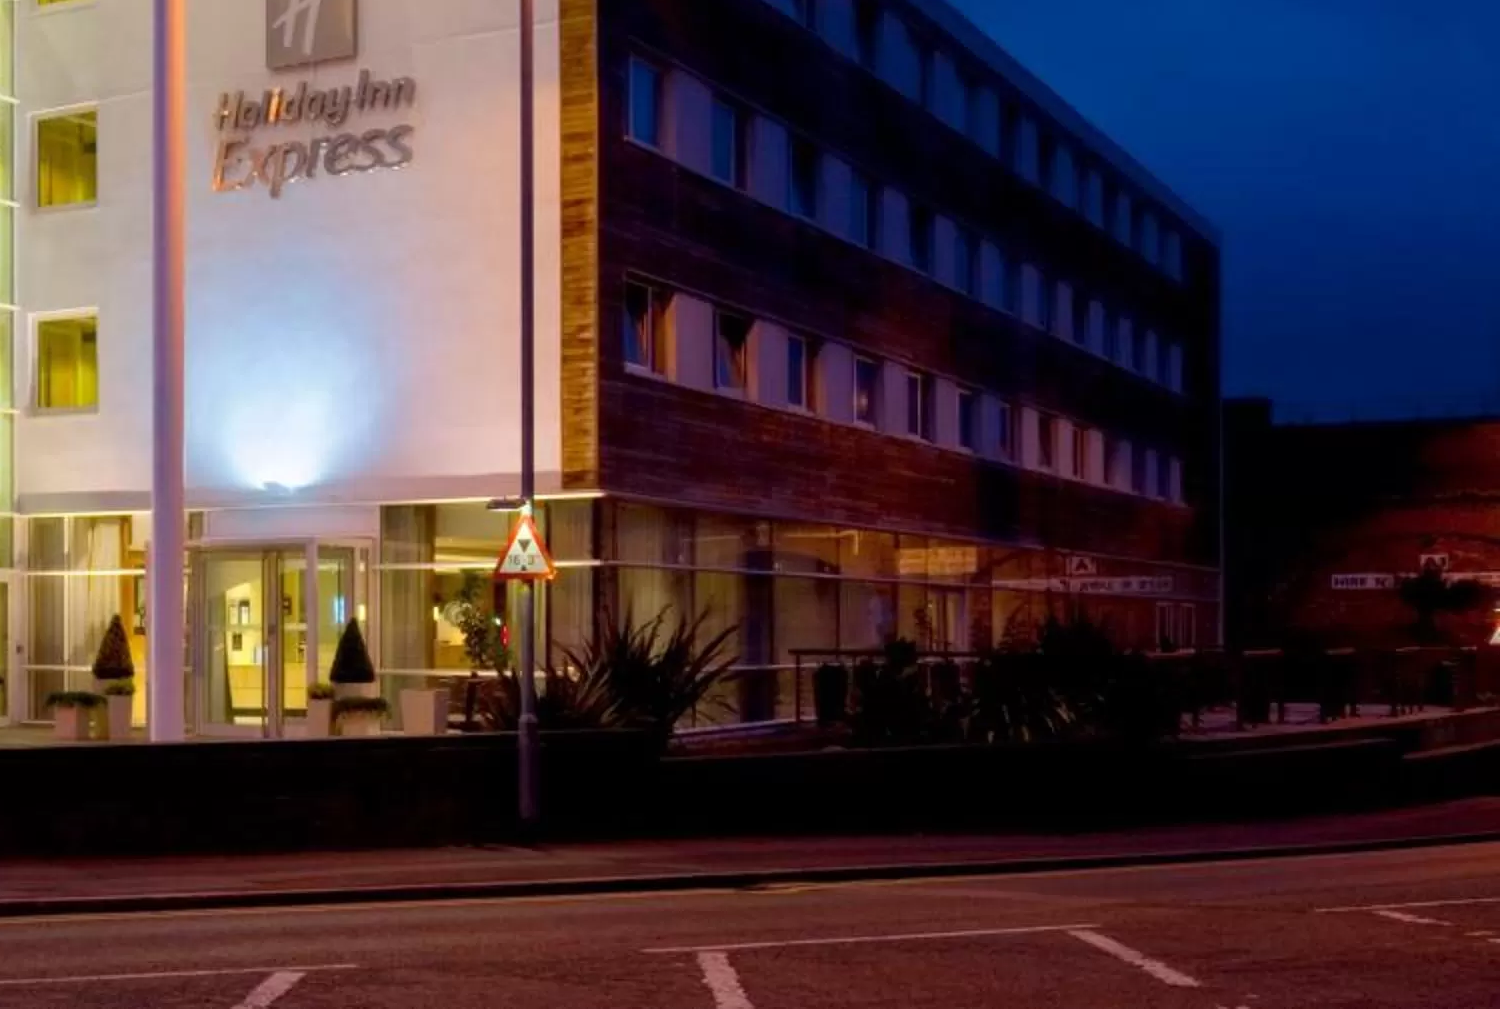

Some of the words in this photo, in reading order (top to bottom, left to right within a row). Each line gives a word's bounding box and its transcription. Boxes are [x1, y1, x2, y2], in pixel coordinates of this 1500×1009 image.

[214, 82, 350, 131] Holiday
[356, 68, 417, 113] Inn
[212, 124, 415, 199] Express
